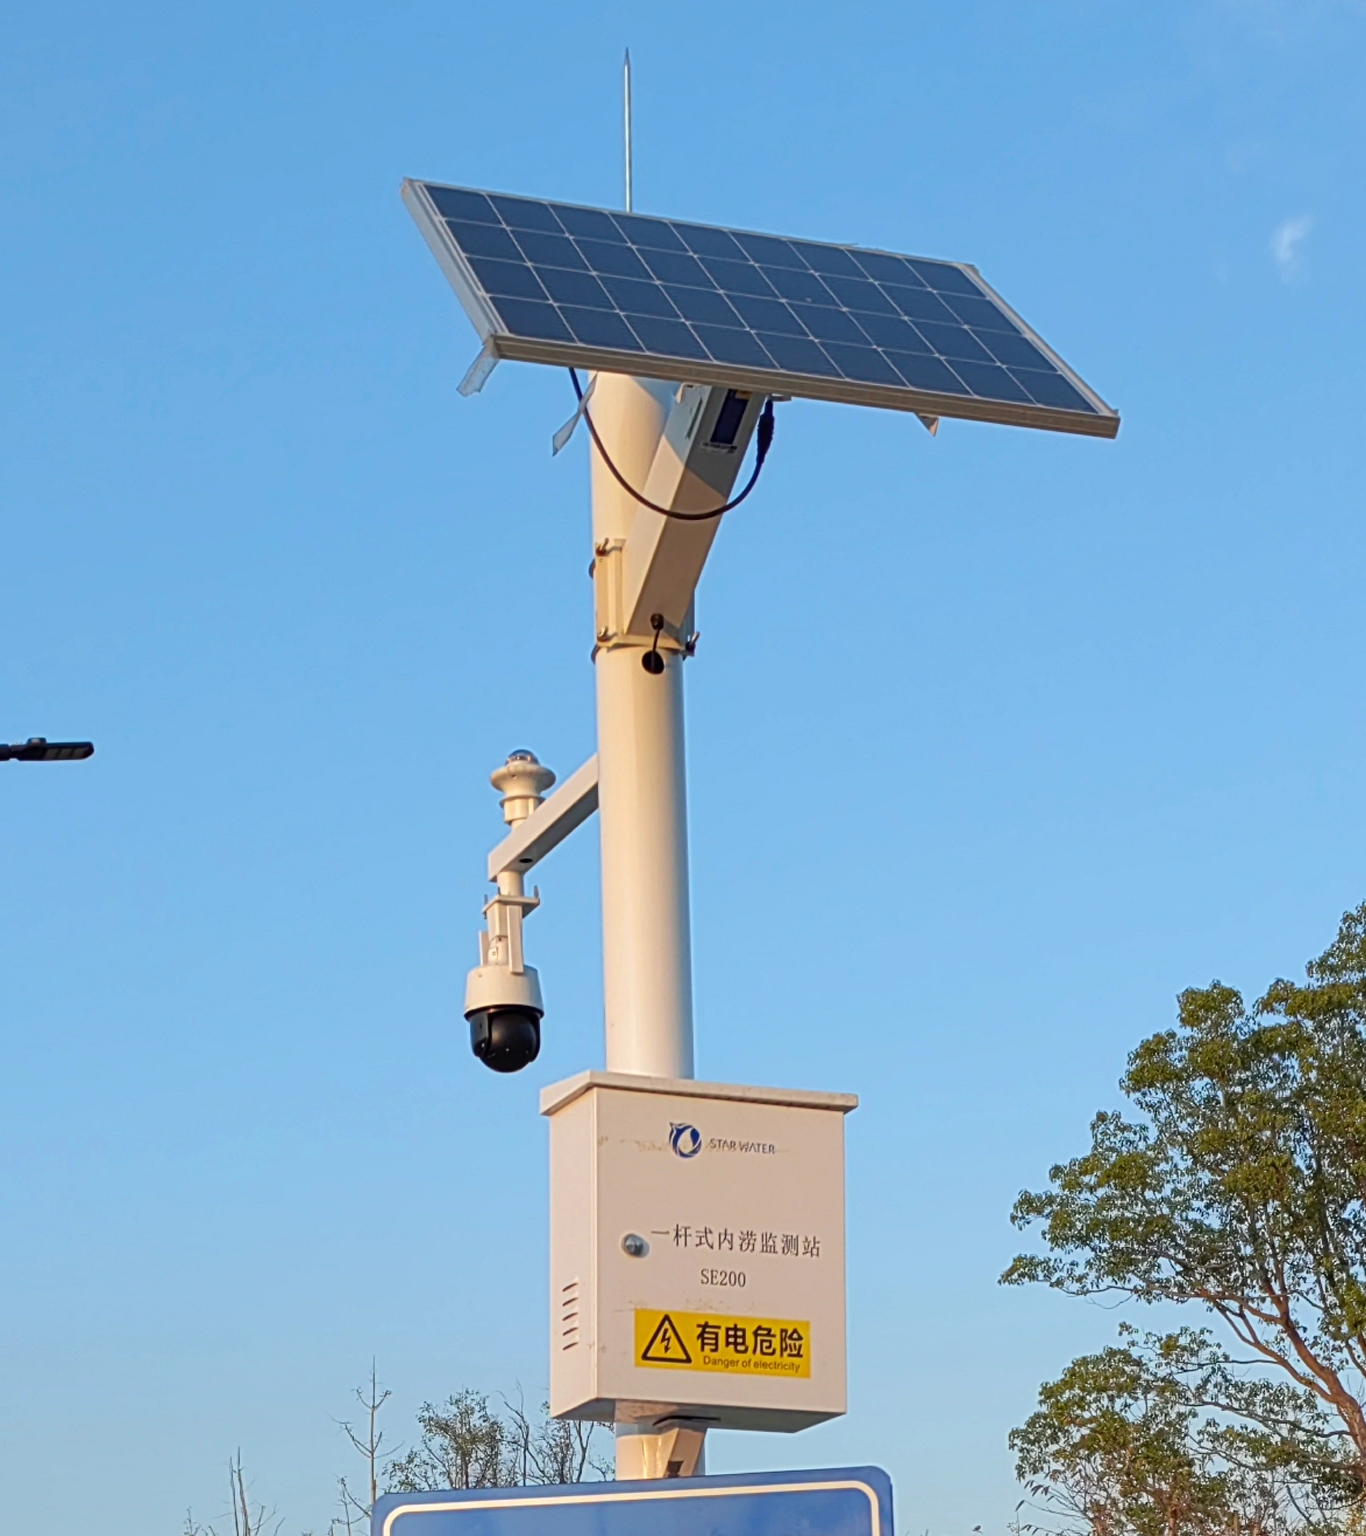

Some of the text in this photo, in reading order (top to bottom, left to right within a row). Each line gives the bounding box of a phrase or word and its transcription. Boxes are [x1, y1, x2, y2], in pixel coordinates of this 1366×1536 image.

[709, 1138, 775, 1154] STAR WATER
[651, 1223, 821, 1259] 一杆式内涝监测站
[700, 1268, 747, 1288] SE200
[696, 1321, 804, 1359] 有电危险
[703, 1356, 801, 1373] Danger of electricity
